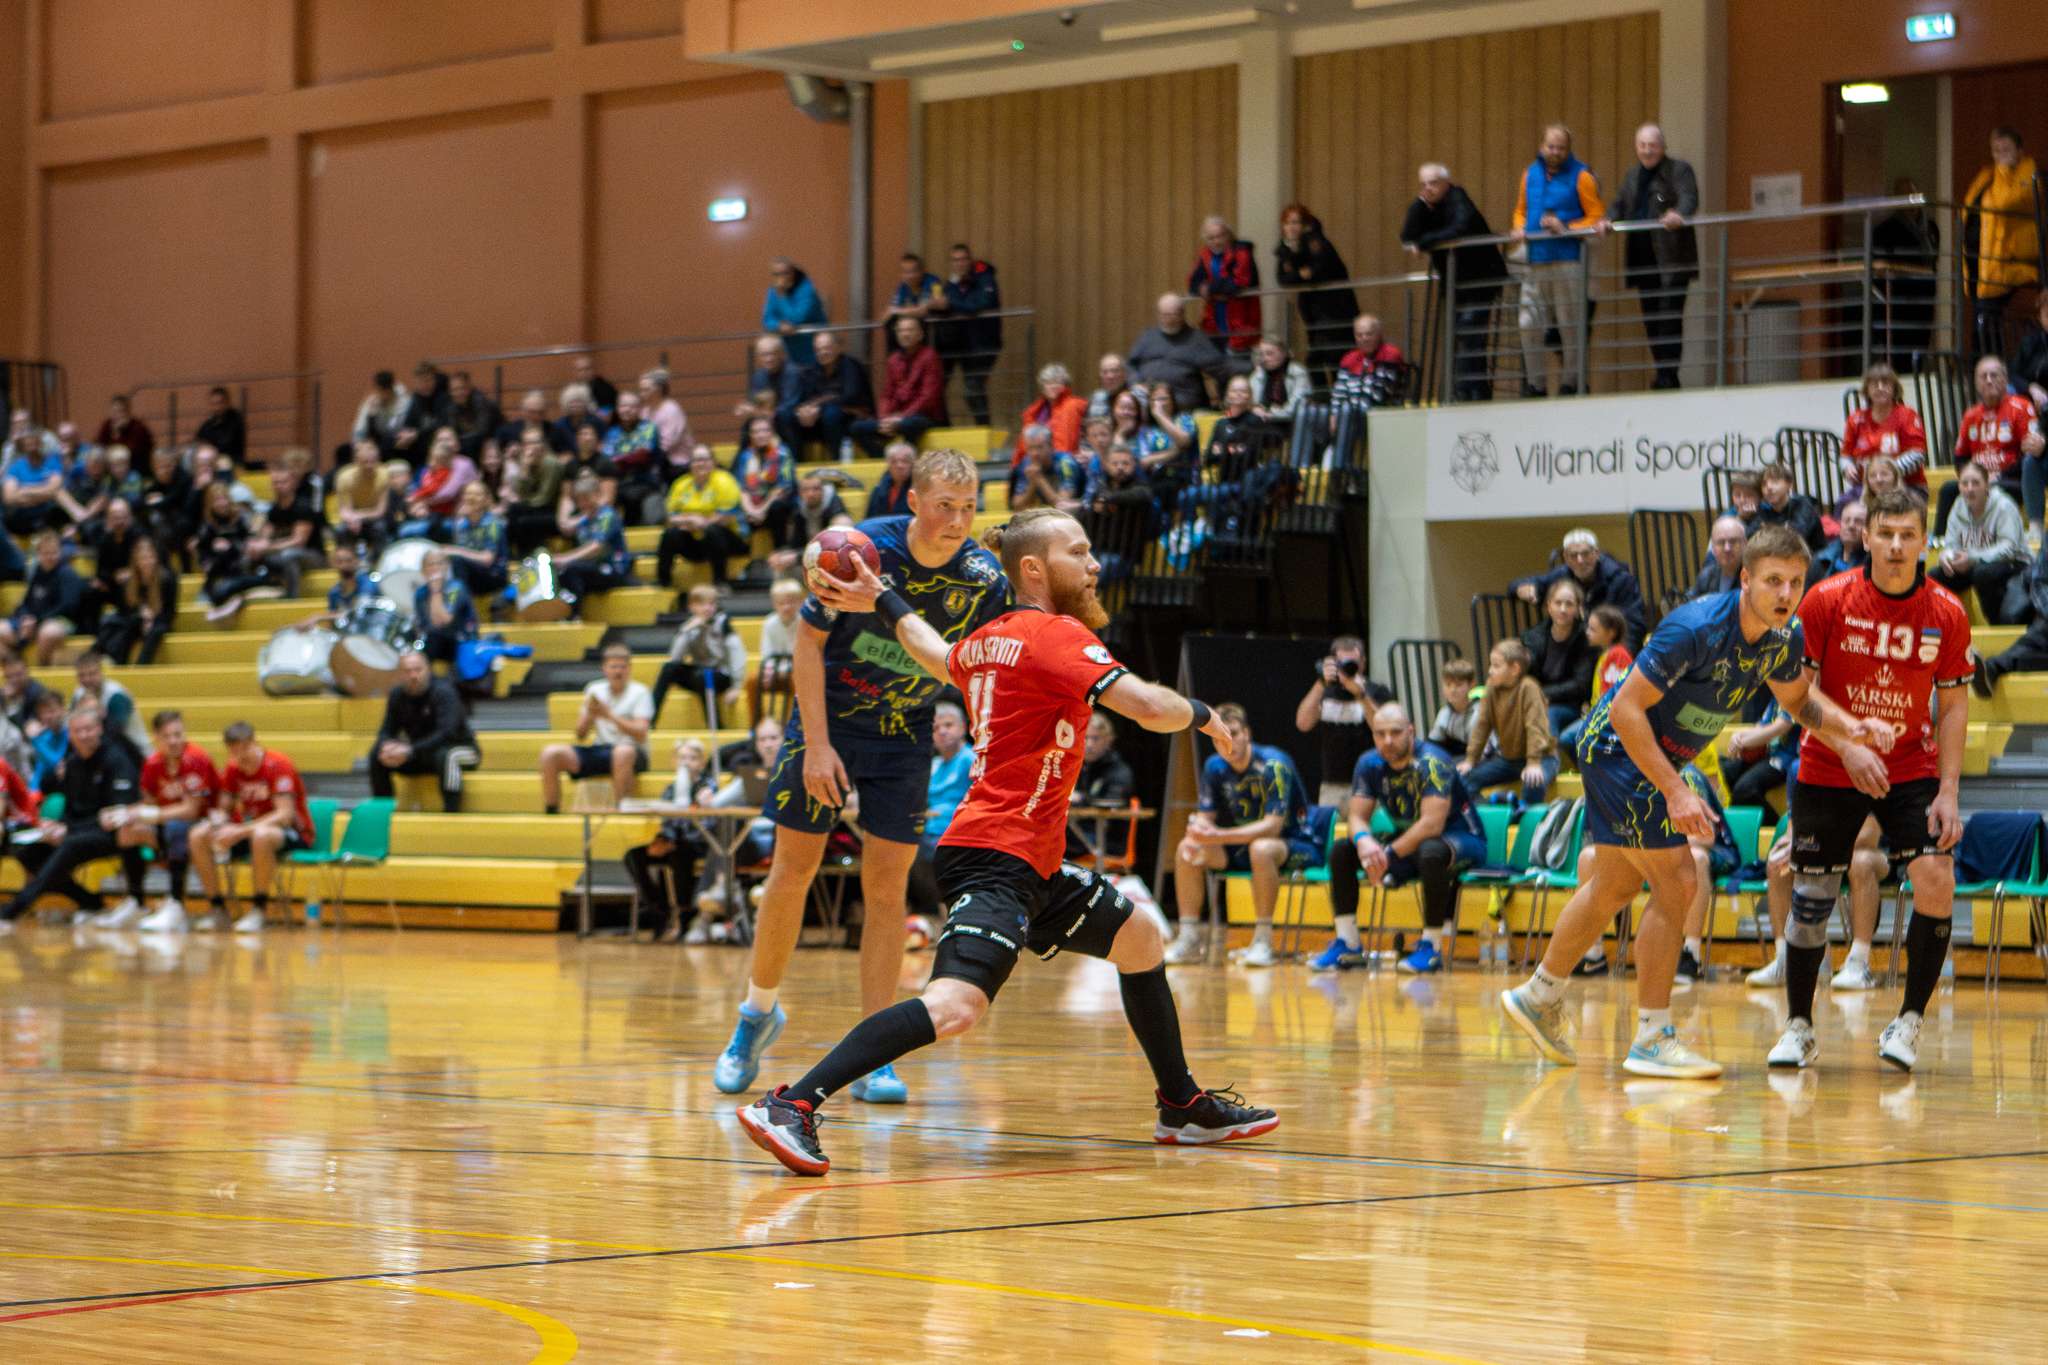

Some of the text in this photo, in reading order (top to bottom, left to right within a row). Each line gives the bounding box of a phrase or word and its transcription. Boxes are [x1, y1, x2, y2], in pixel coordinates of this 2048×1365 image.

[1515, 437, 1625, 484] Viljandi
[1873, 621, 1915, 662] 13
[1846, 684, 1913, 708] VÄRSKA
[1851, 703, 1905, 720] ORIGINAAL
